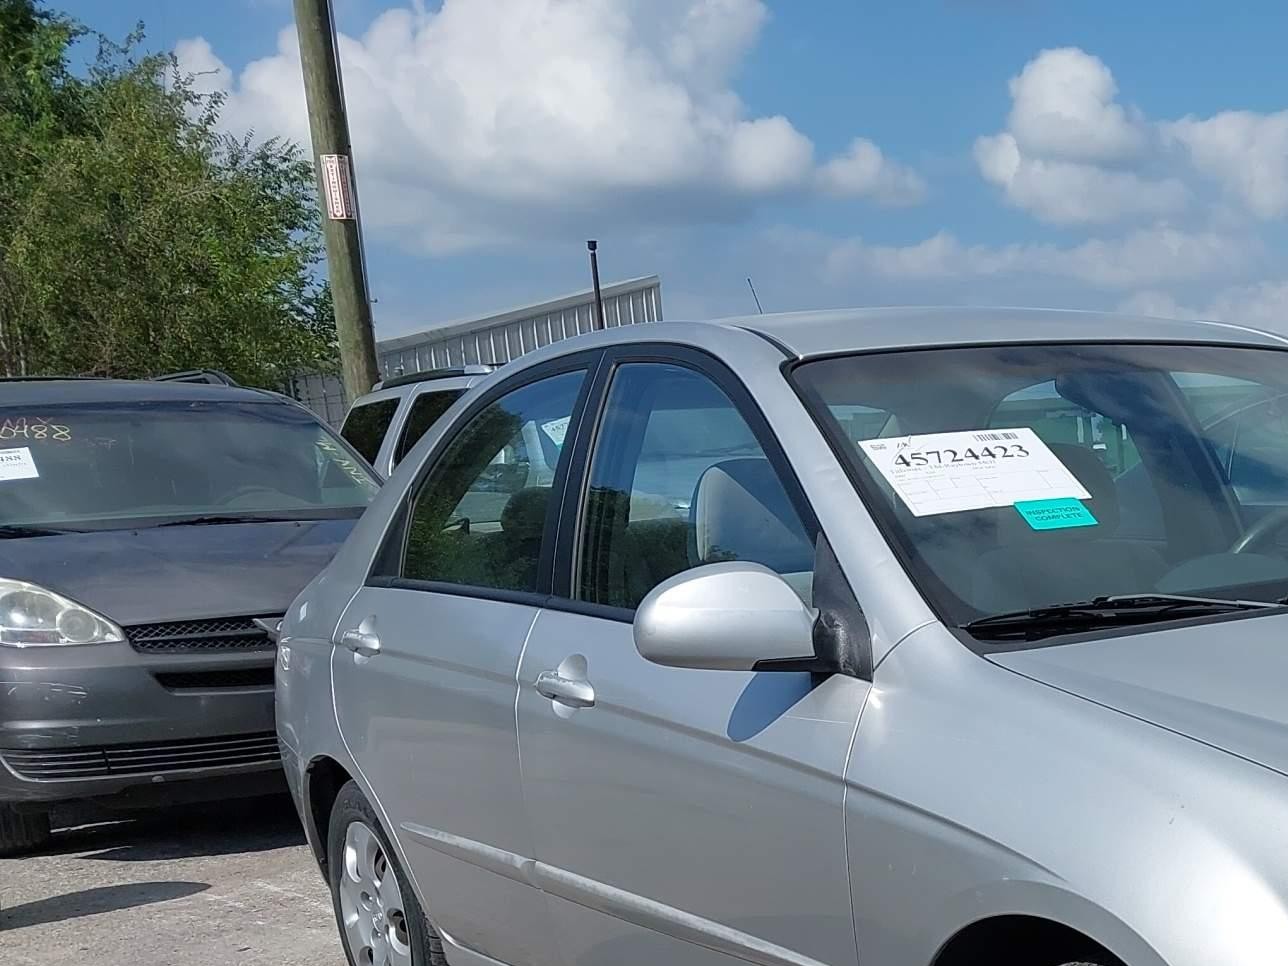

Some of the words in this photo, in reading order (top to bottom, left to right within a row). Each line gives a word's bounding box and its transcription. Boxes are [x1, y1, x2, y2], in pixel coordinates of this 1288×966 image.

[893, 444, 1030, 467] 45724423
[1025, 505, 1082, 516] INSPECTION
[1034, 511, 1085, 522] COMPLETE
